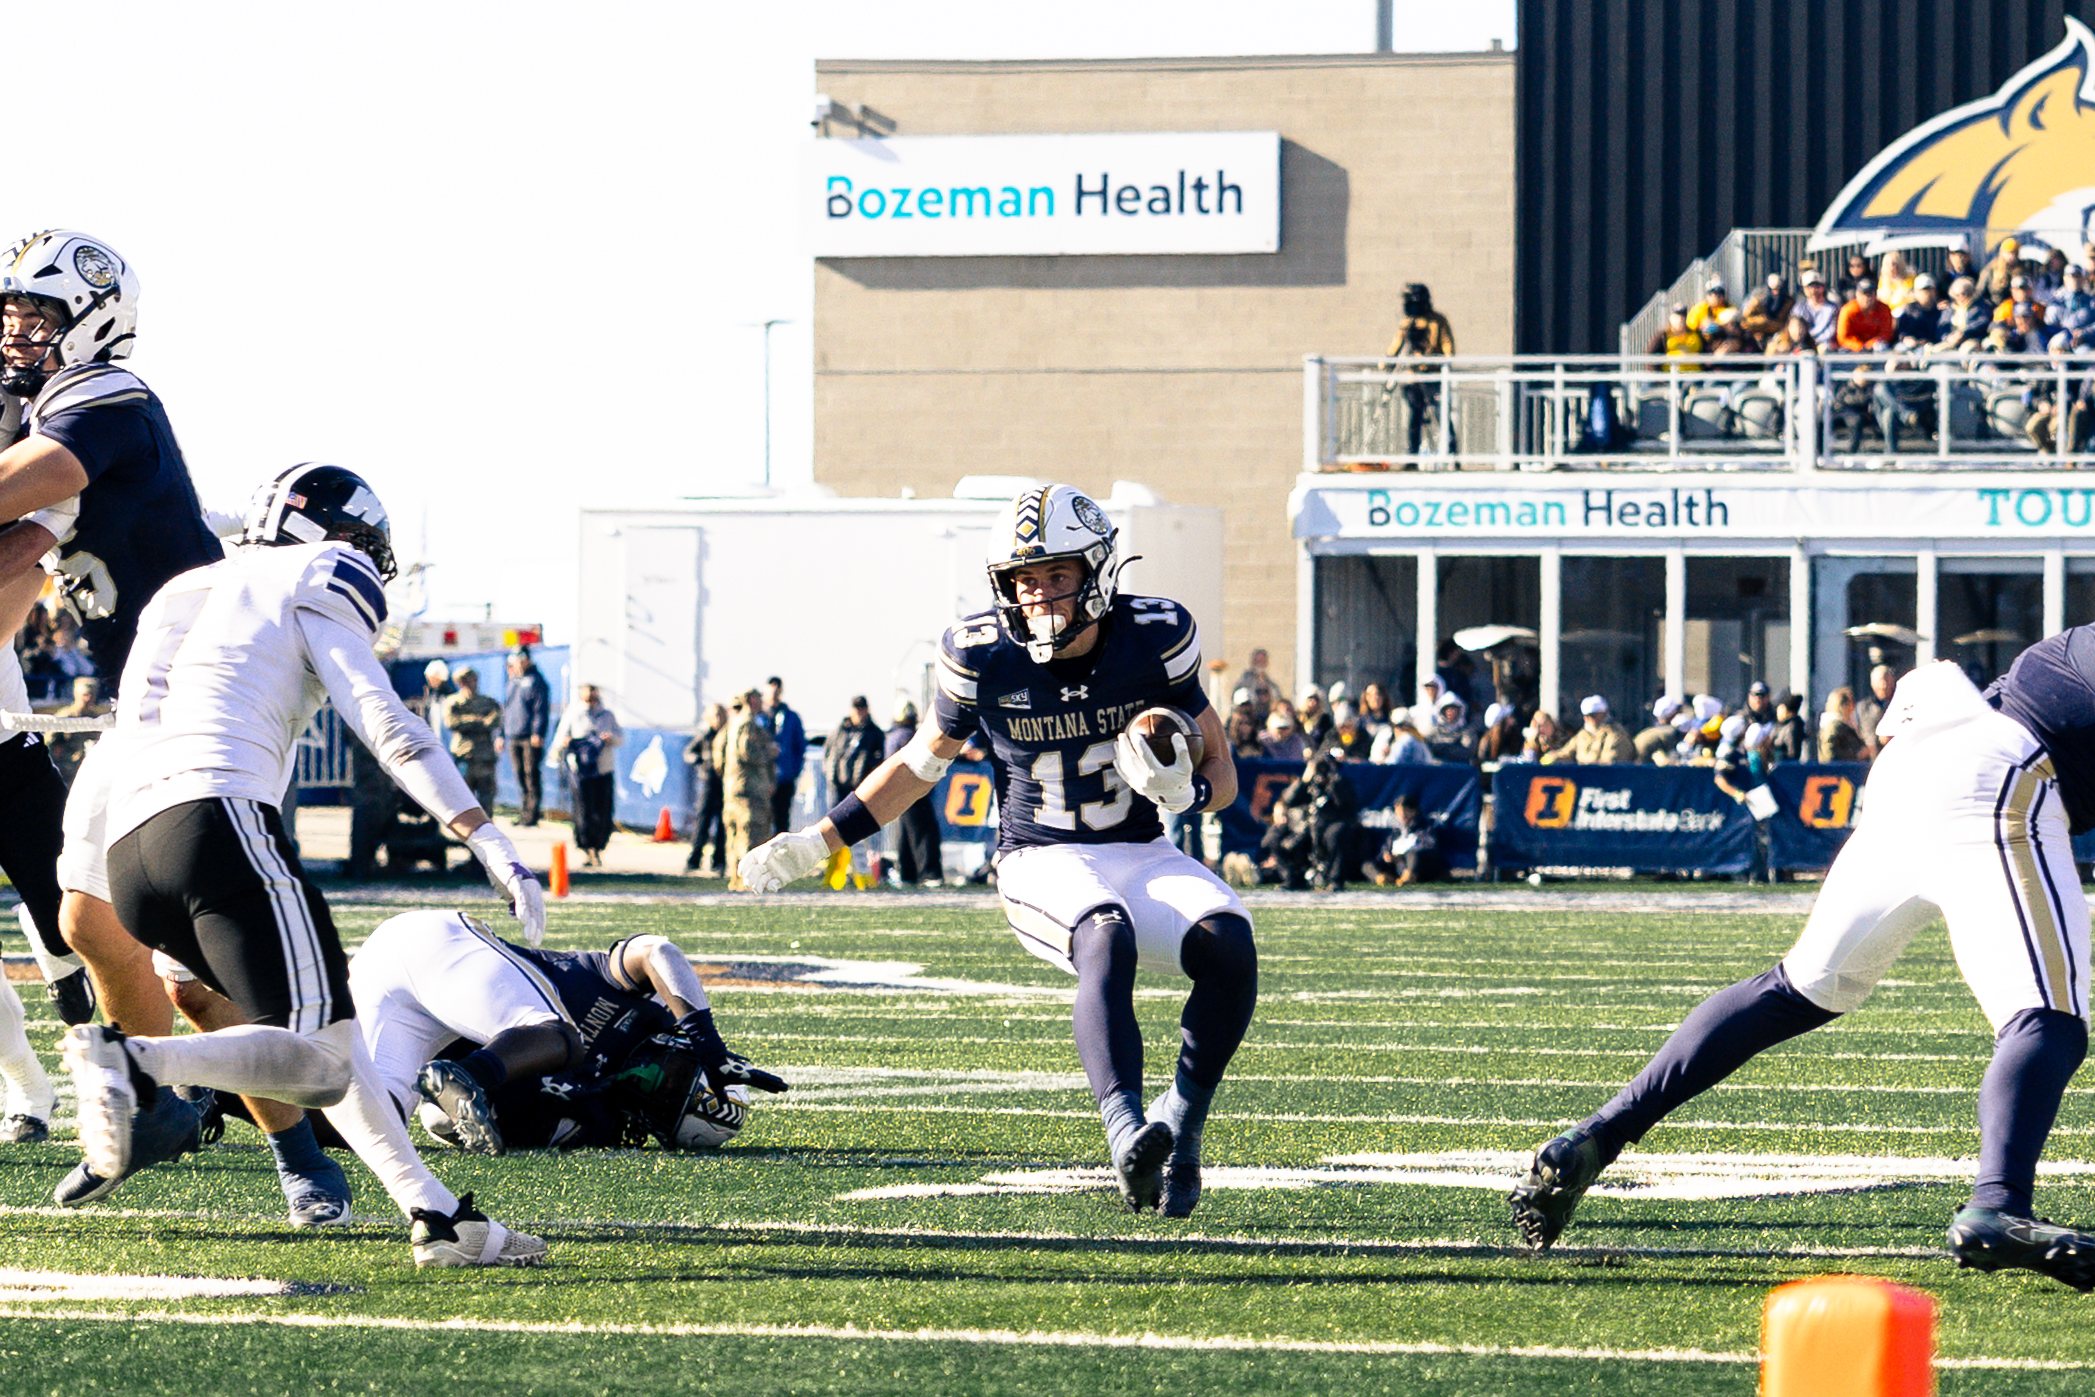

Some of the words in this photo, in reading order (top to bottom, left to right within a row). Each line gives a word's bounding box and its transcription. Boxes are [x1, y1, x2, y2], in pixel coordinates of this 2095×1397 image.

[827, 175, 1055, 220] Bozeman
[1075, 169, 1244, 216] Health
[1367, 489, 1566, 527] Bozeman
[1582, 488, 1730, 527] Health
[1130, 598, 1178, 626] 13
[1006, 711, 1090, 742] MONTANA
[1030, 740, 1133, 832] 13
[1579, 787, 1632, 810] First
